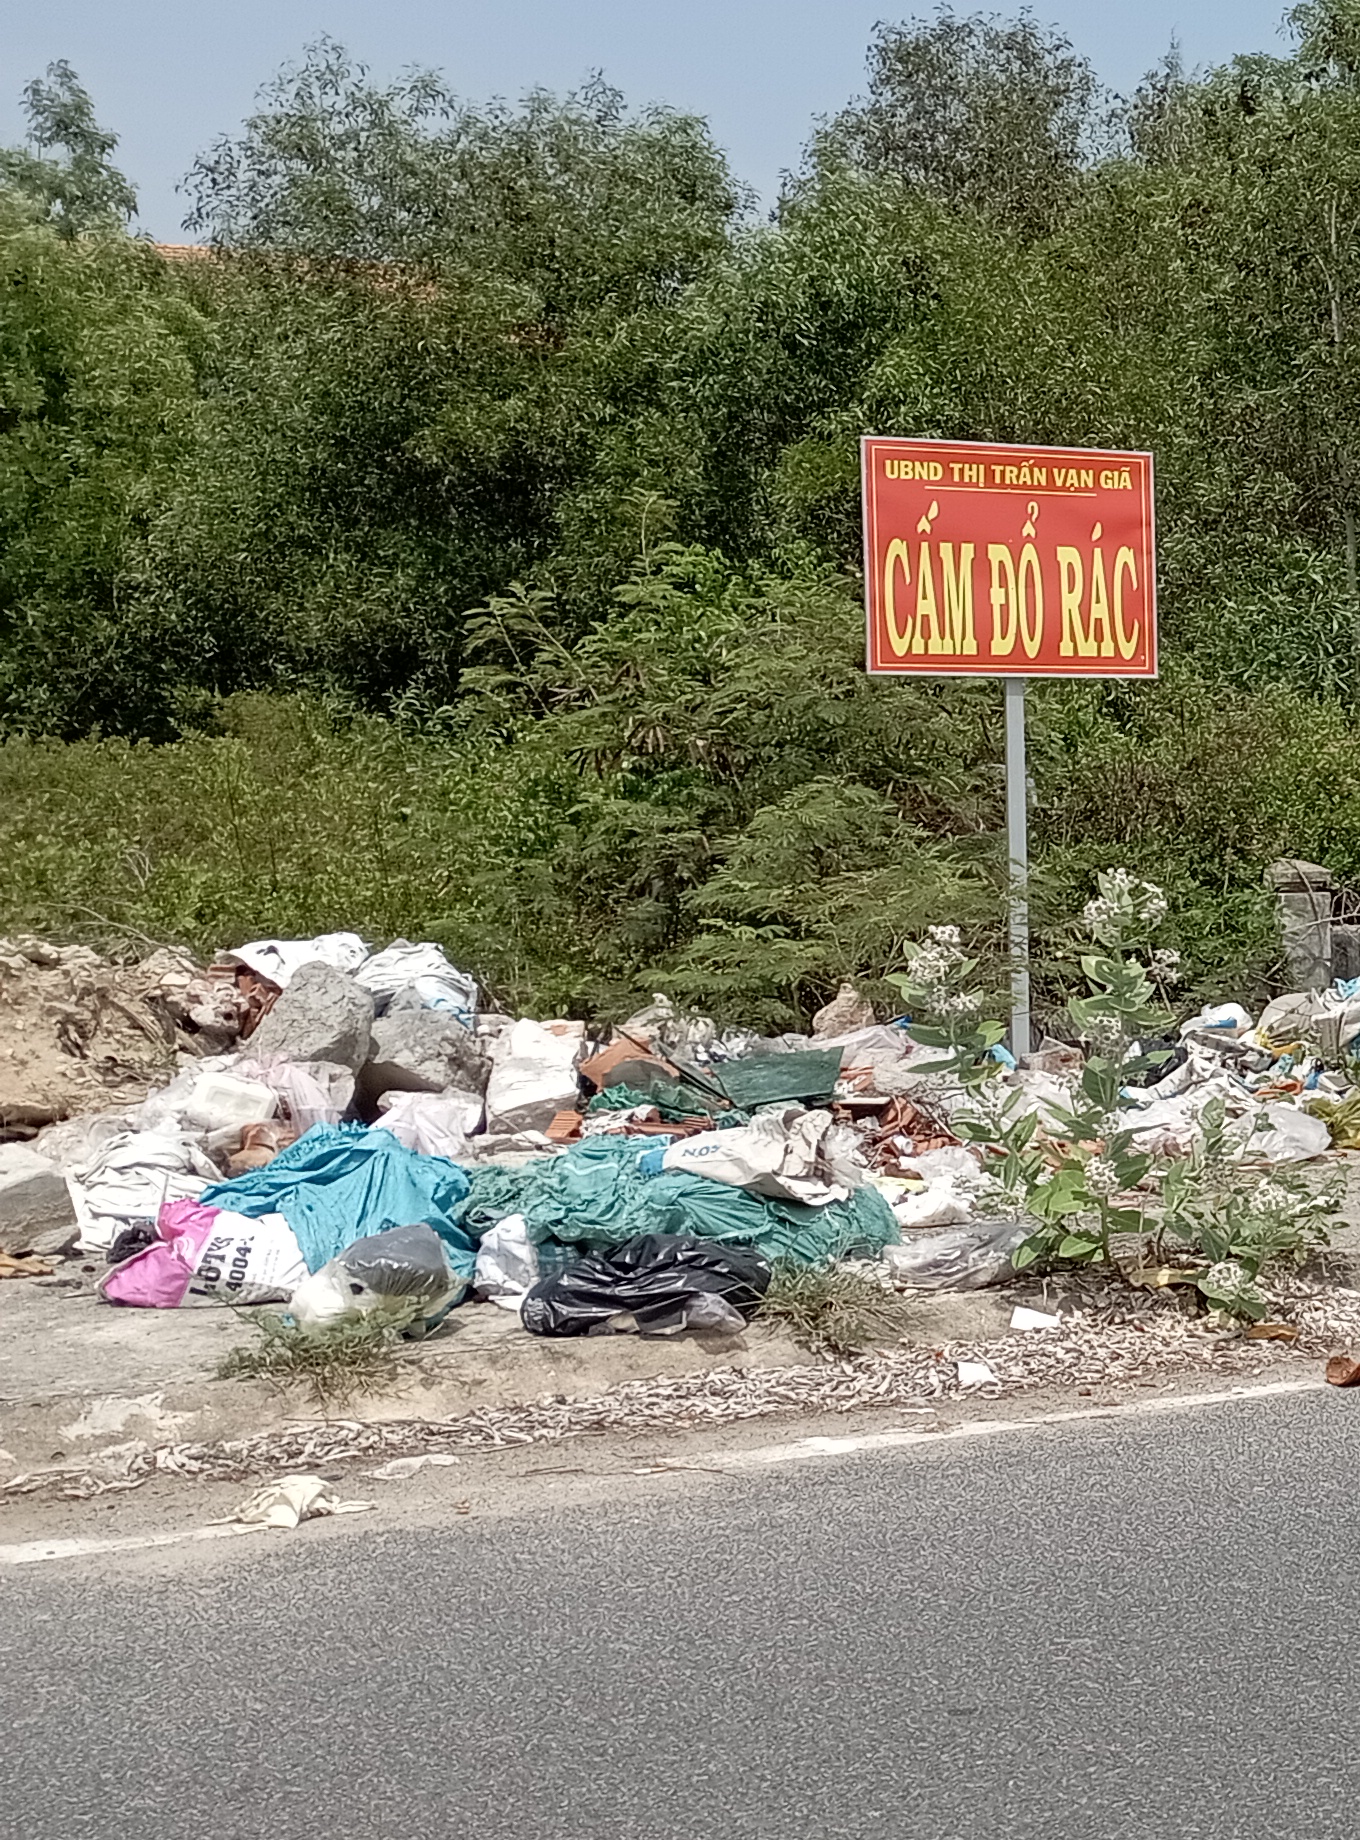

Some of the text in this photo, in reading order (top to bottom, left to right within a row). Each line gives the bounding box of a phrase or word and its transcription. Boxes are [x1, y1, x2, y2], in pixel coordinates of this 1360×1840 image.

[884, 459, 1133, 491] UBND THỊ TRẤN VẠN GIÃ
[884, 500, 1140, 660] CẤM ĐỔ RÁC
